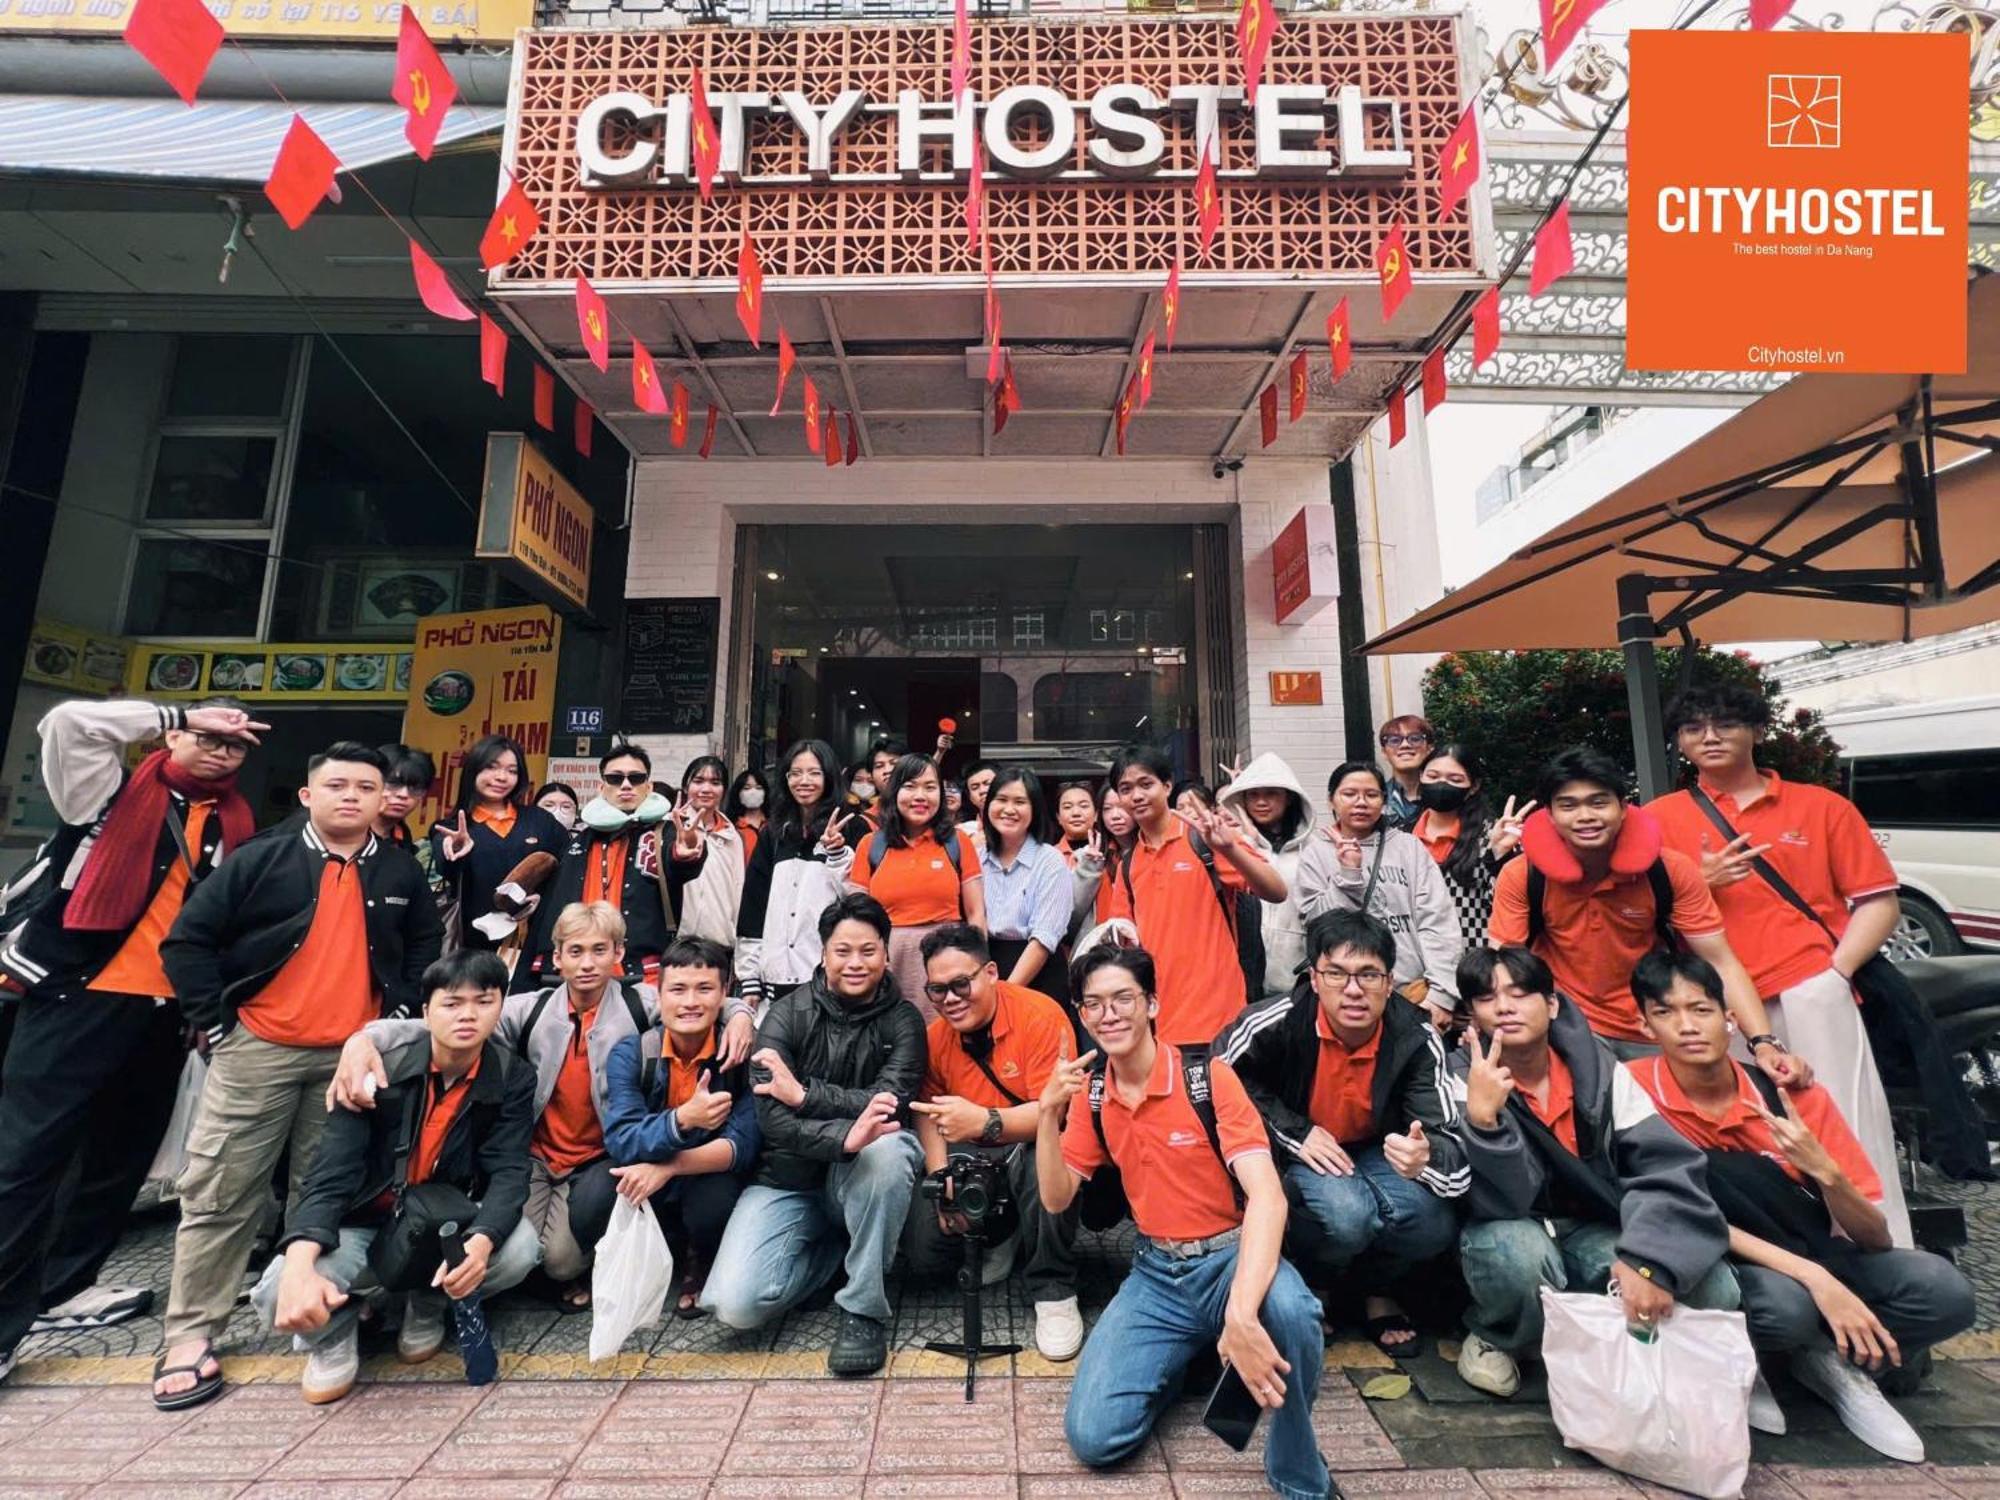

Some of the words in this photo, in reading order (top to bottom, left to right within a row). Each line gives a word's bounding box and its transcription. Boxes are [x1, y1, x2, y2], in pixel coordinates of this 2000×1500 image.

[321, 5, 361, 22] 116
[574, 90, 865, 179] CITY
[898, 84, 1413, 174] HOSTEL
[522, 470, 555, 543] PHỞ
[553, 502, 589, 576] NGON
[424, 618, 476, 649] PHỞ
[480, 615, 556, 644] NGON
[503, 662, 537, 702] TÁI
[570, 710, 600, 726] 116
